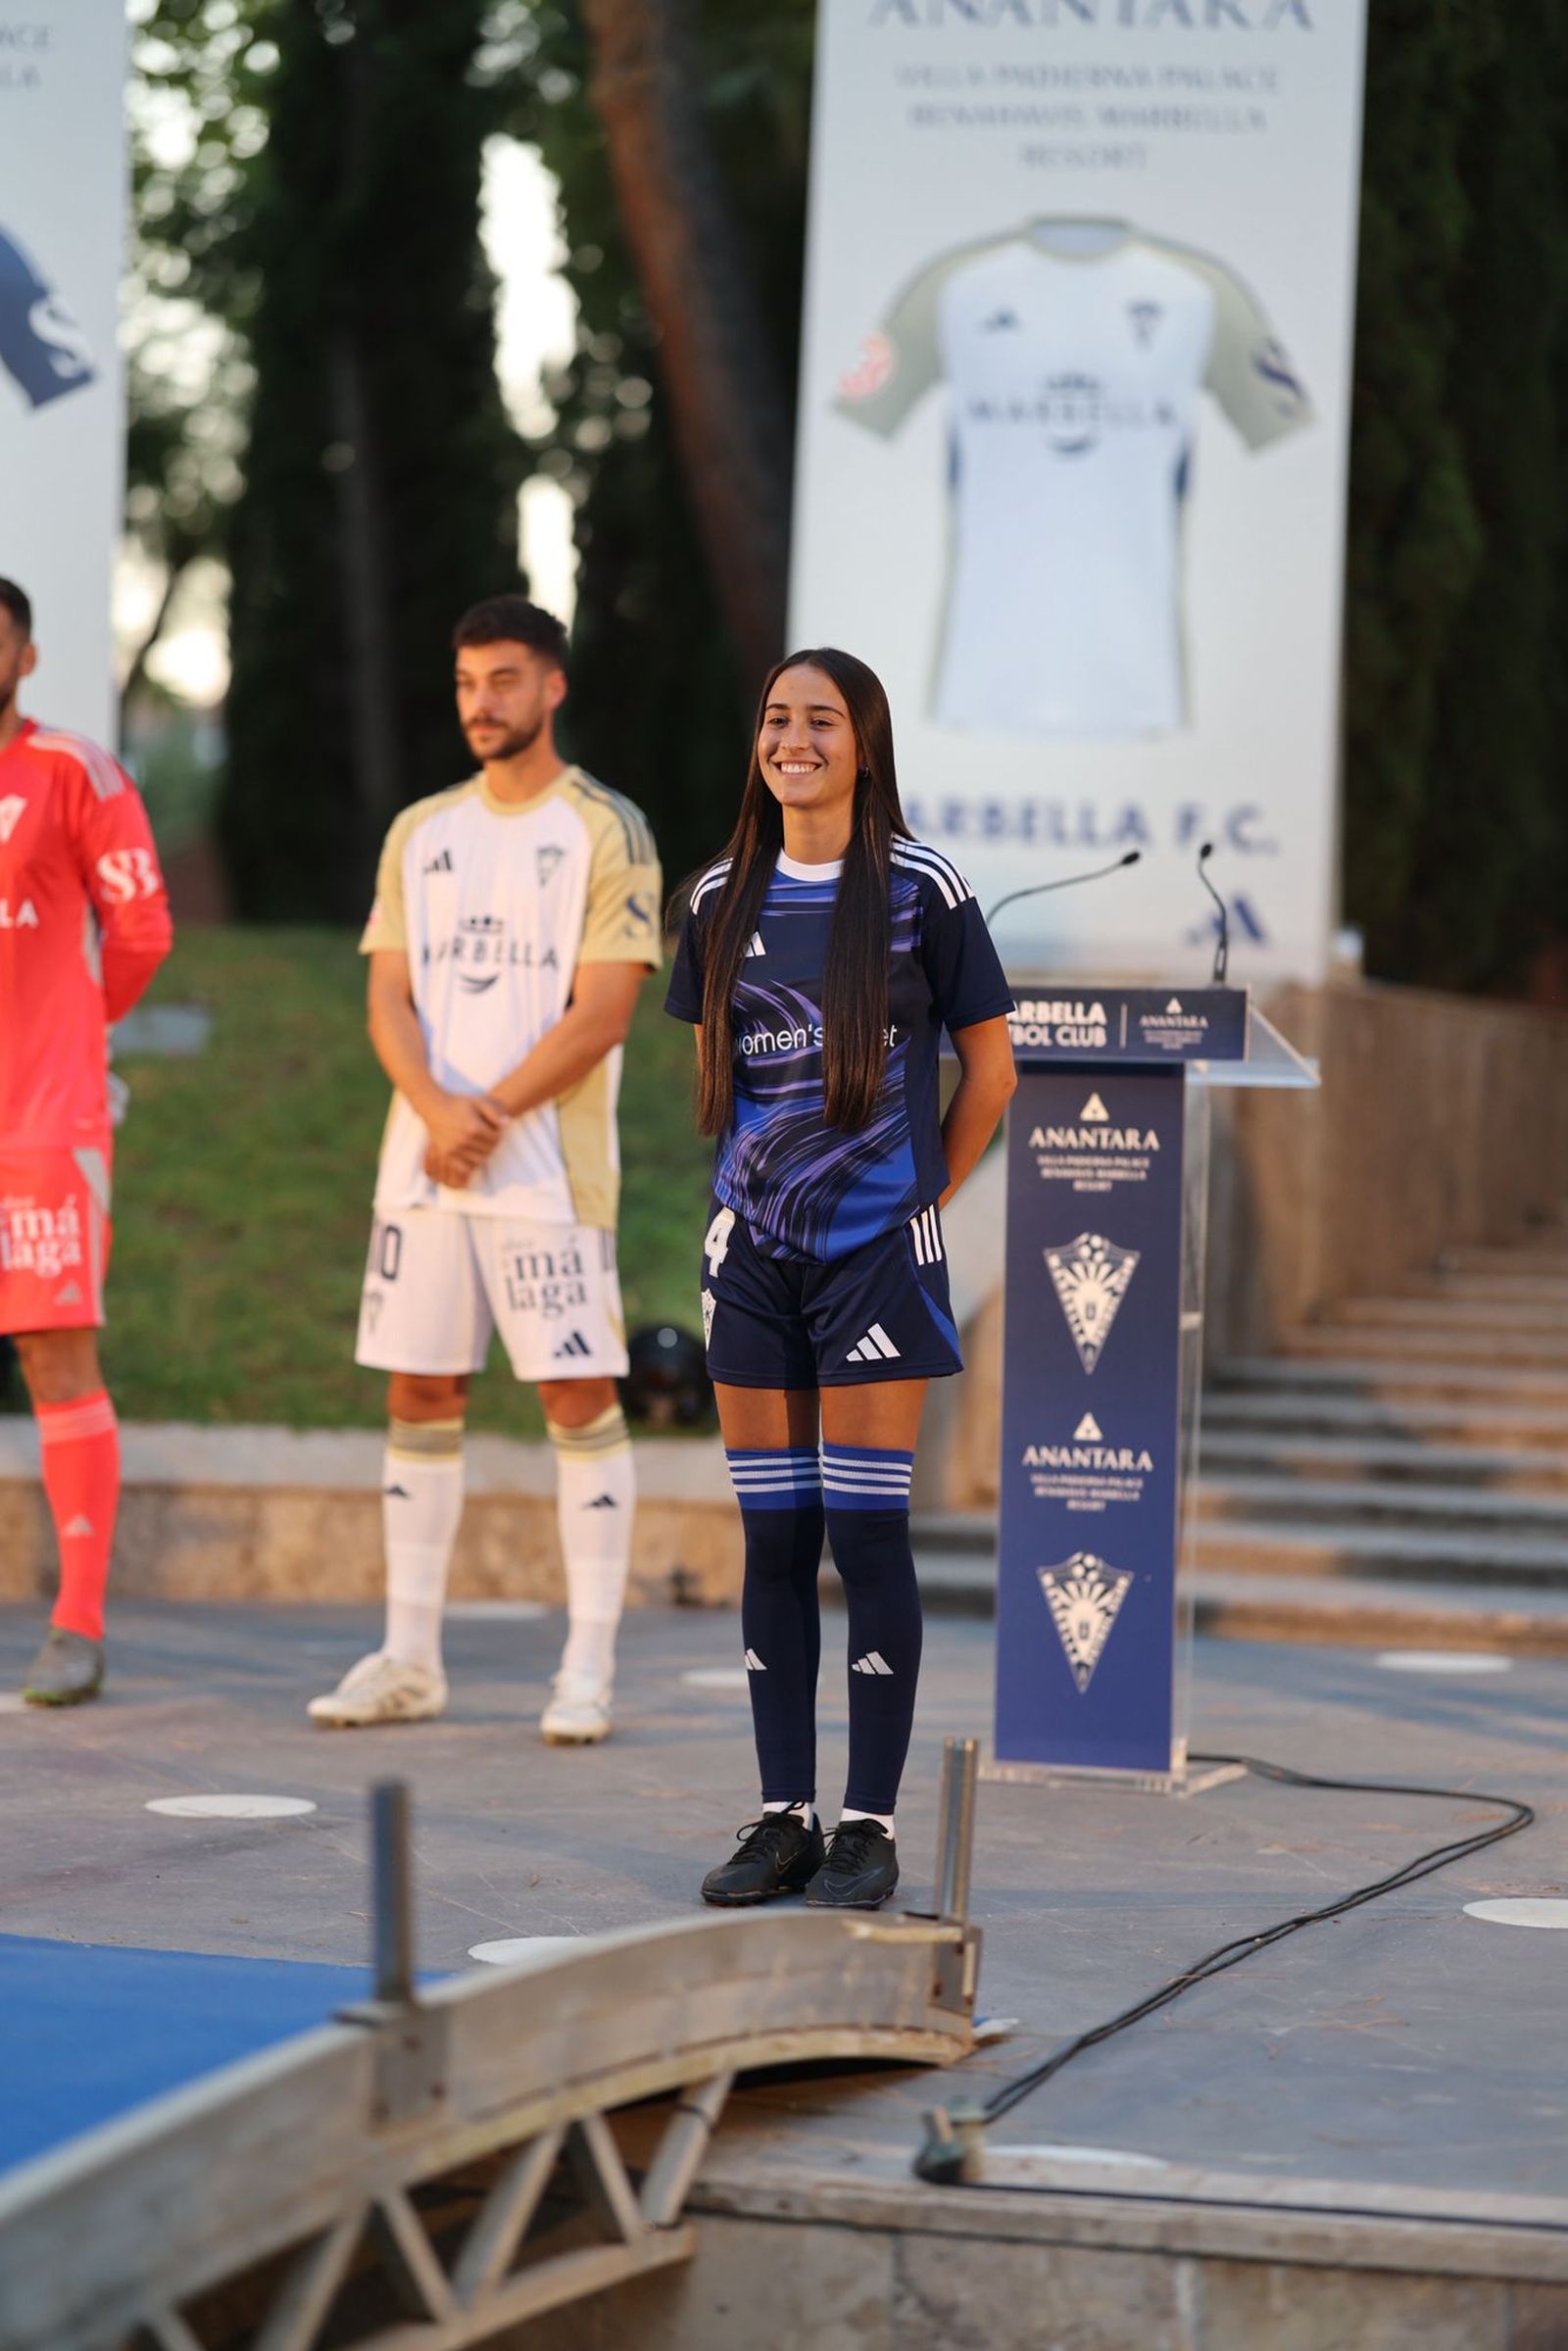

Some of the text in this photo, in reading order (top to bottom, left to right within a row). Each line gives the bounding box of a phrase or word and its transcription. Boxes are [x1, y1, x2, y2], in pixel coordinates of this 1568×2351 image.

[905, 796, 1151, 845] ARBELLA
[1006, 1001, 1106, 1025] RBELLA
[1008, 1025, 1106, 1048] BOL CLUB
[1028, 1126, 1160, 1151] ANANTARA
[1021, 1445, 1153, 1472] ANANTARA
